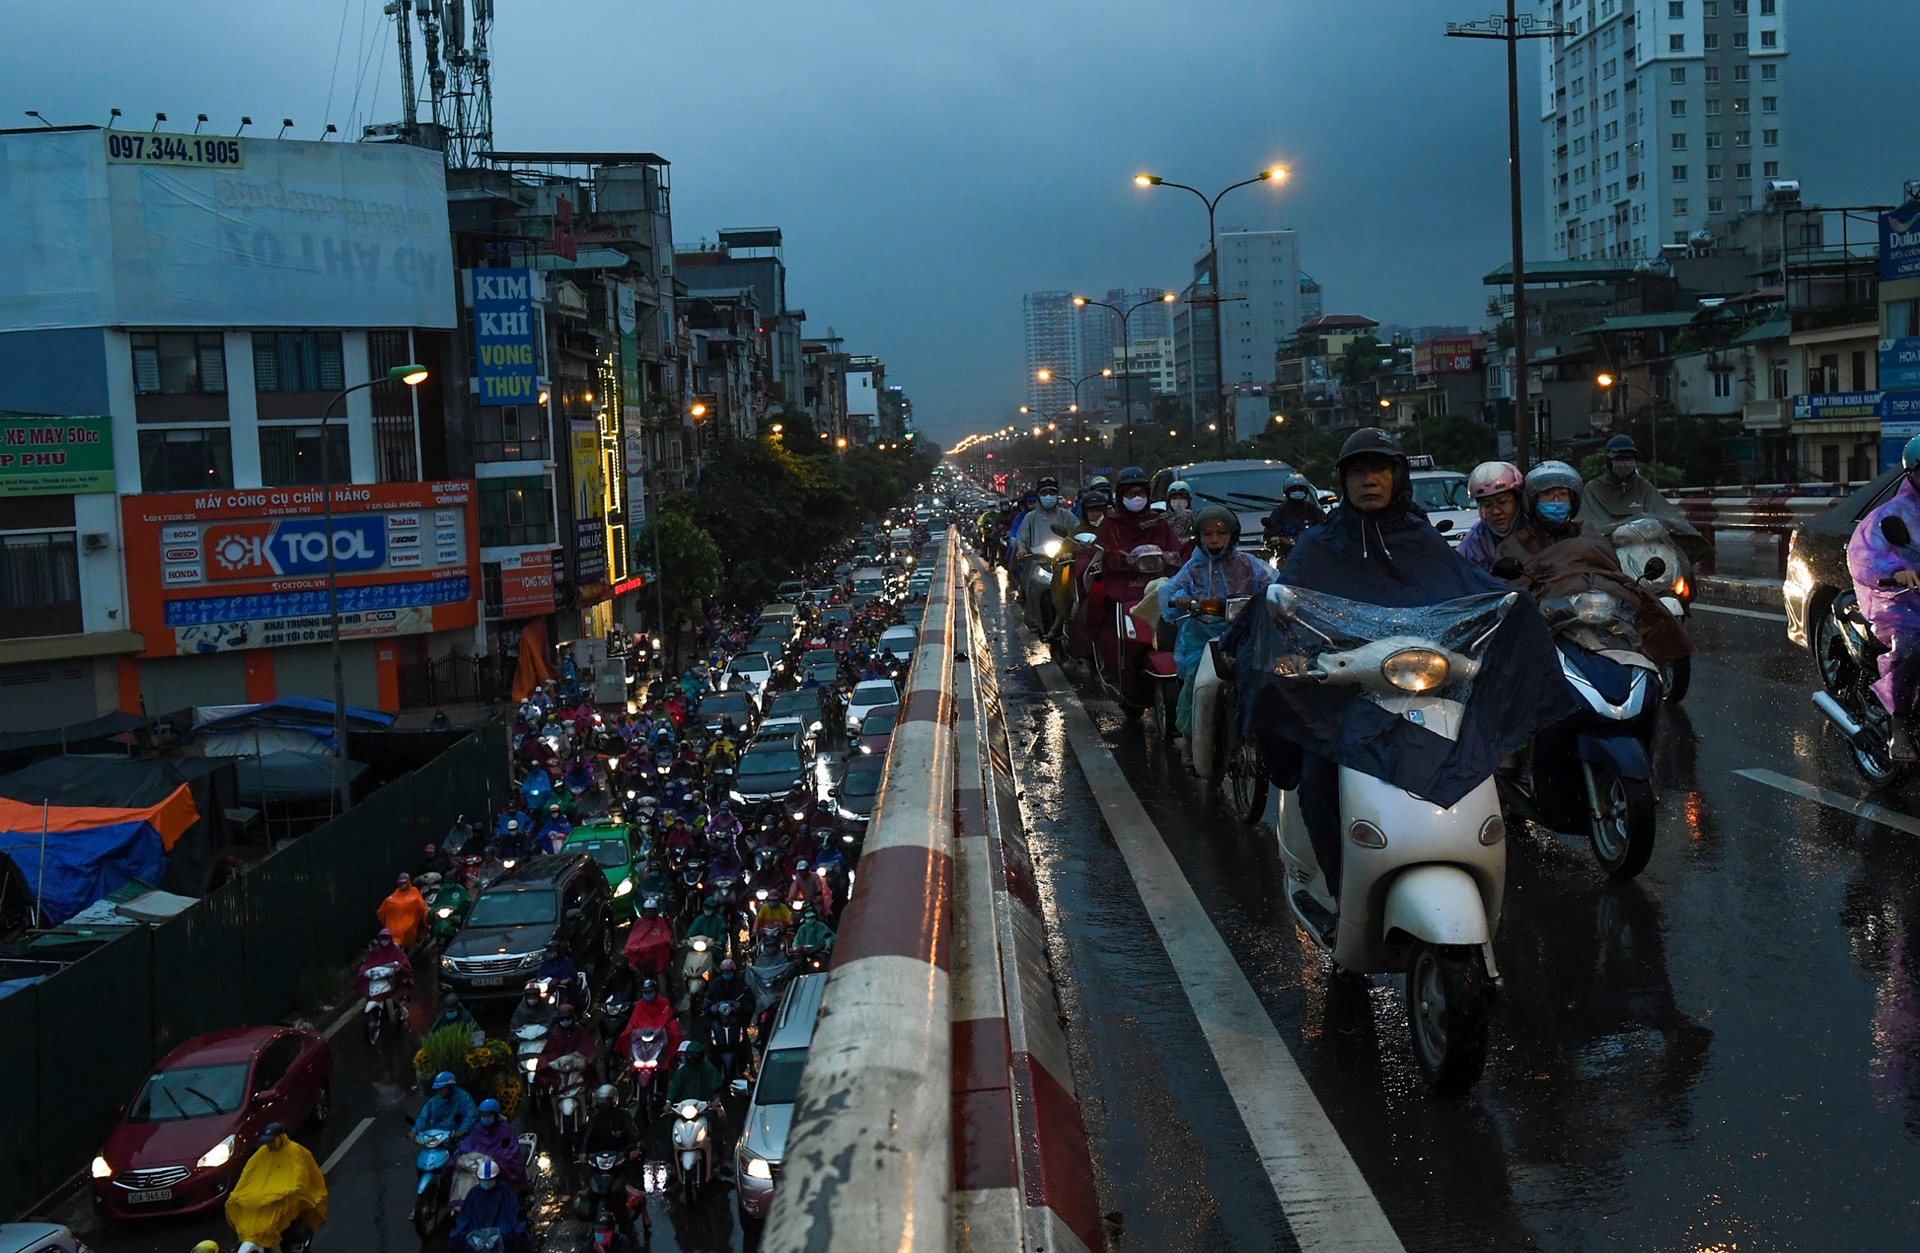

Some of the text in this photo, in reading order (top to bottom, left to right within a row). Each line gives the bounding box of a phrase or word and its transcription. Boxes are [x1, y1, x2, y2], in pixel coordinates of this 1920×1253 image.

[109, 135, 240, 163] 097.344.1905
[476, 276, 528, 299] KIM
[480, 305, 529, 336] KHÍ
[480, 344, 532, 370] VỌNG
[1454, 356, 1470, 369] CNC
[484, 372, 532, 397] THÚY
[1845, 395, 1862, 405] KHOA
[1892, 398, 1909, 410] THÉP
[6, 424, 98, 445] XE MÁY 50cc
[22, 450, 66, 466] PHÚ
[196, 488, 370, 509] MÁY CÔNG CỤ CHÍN HÃNG
[168, 570, 198, 578] HONDA
[282, 580, 325, 589] OKTOOL.VN
[521, 576, 537, 591] VỌNG
[264, 622, 284, 630] KHAI
[322, 616, 342, 626] ĐIM
[265, 634, 283, 644] BẠN
[287, 633, 300, 641] TỚI
[303, 630, 315, 640] CÓ
